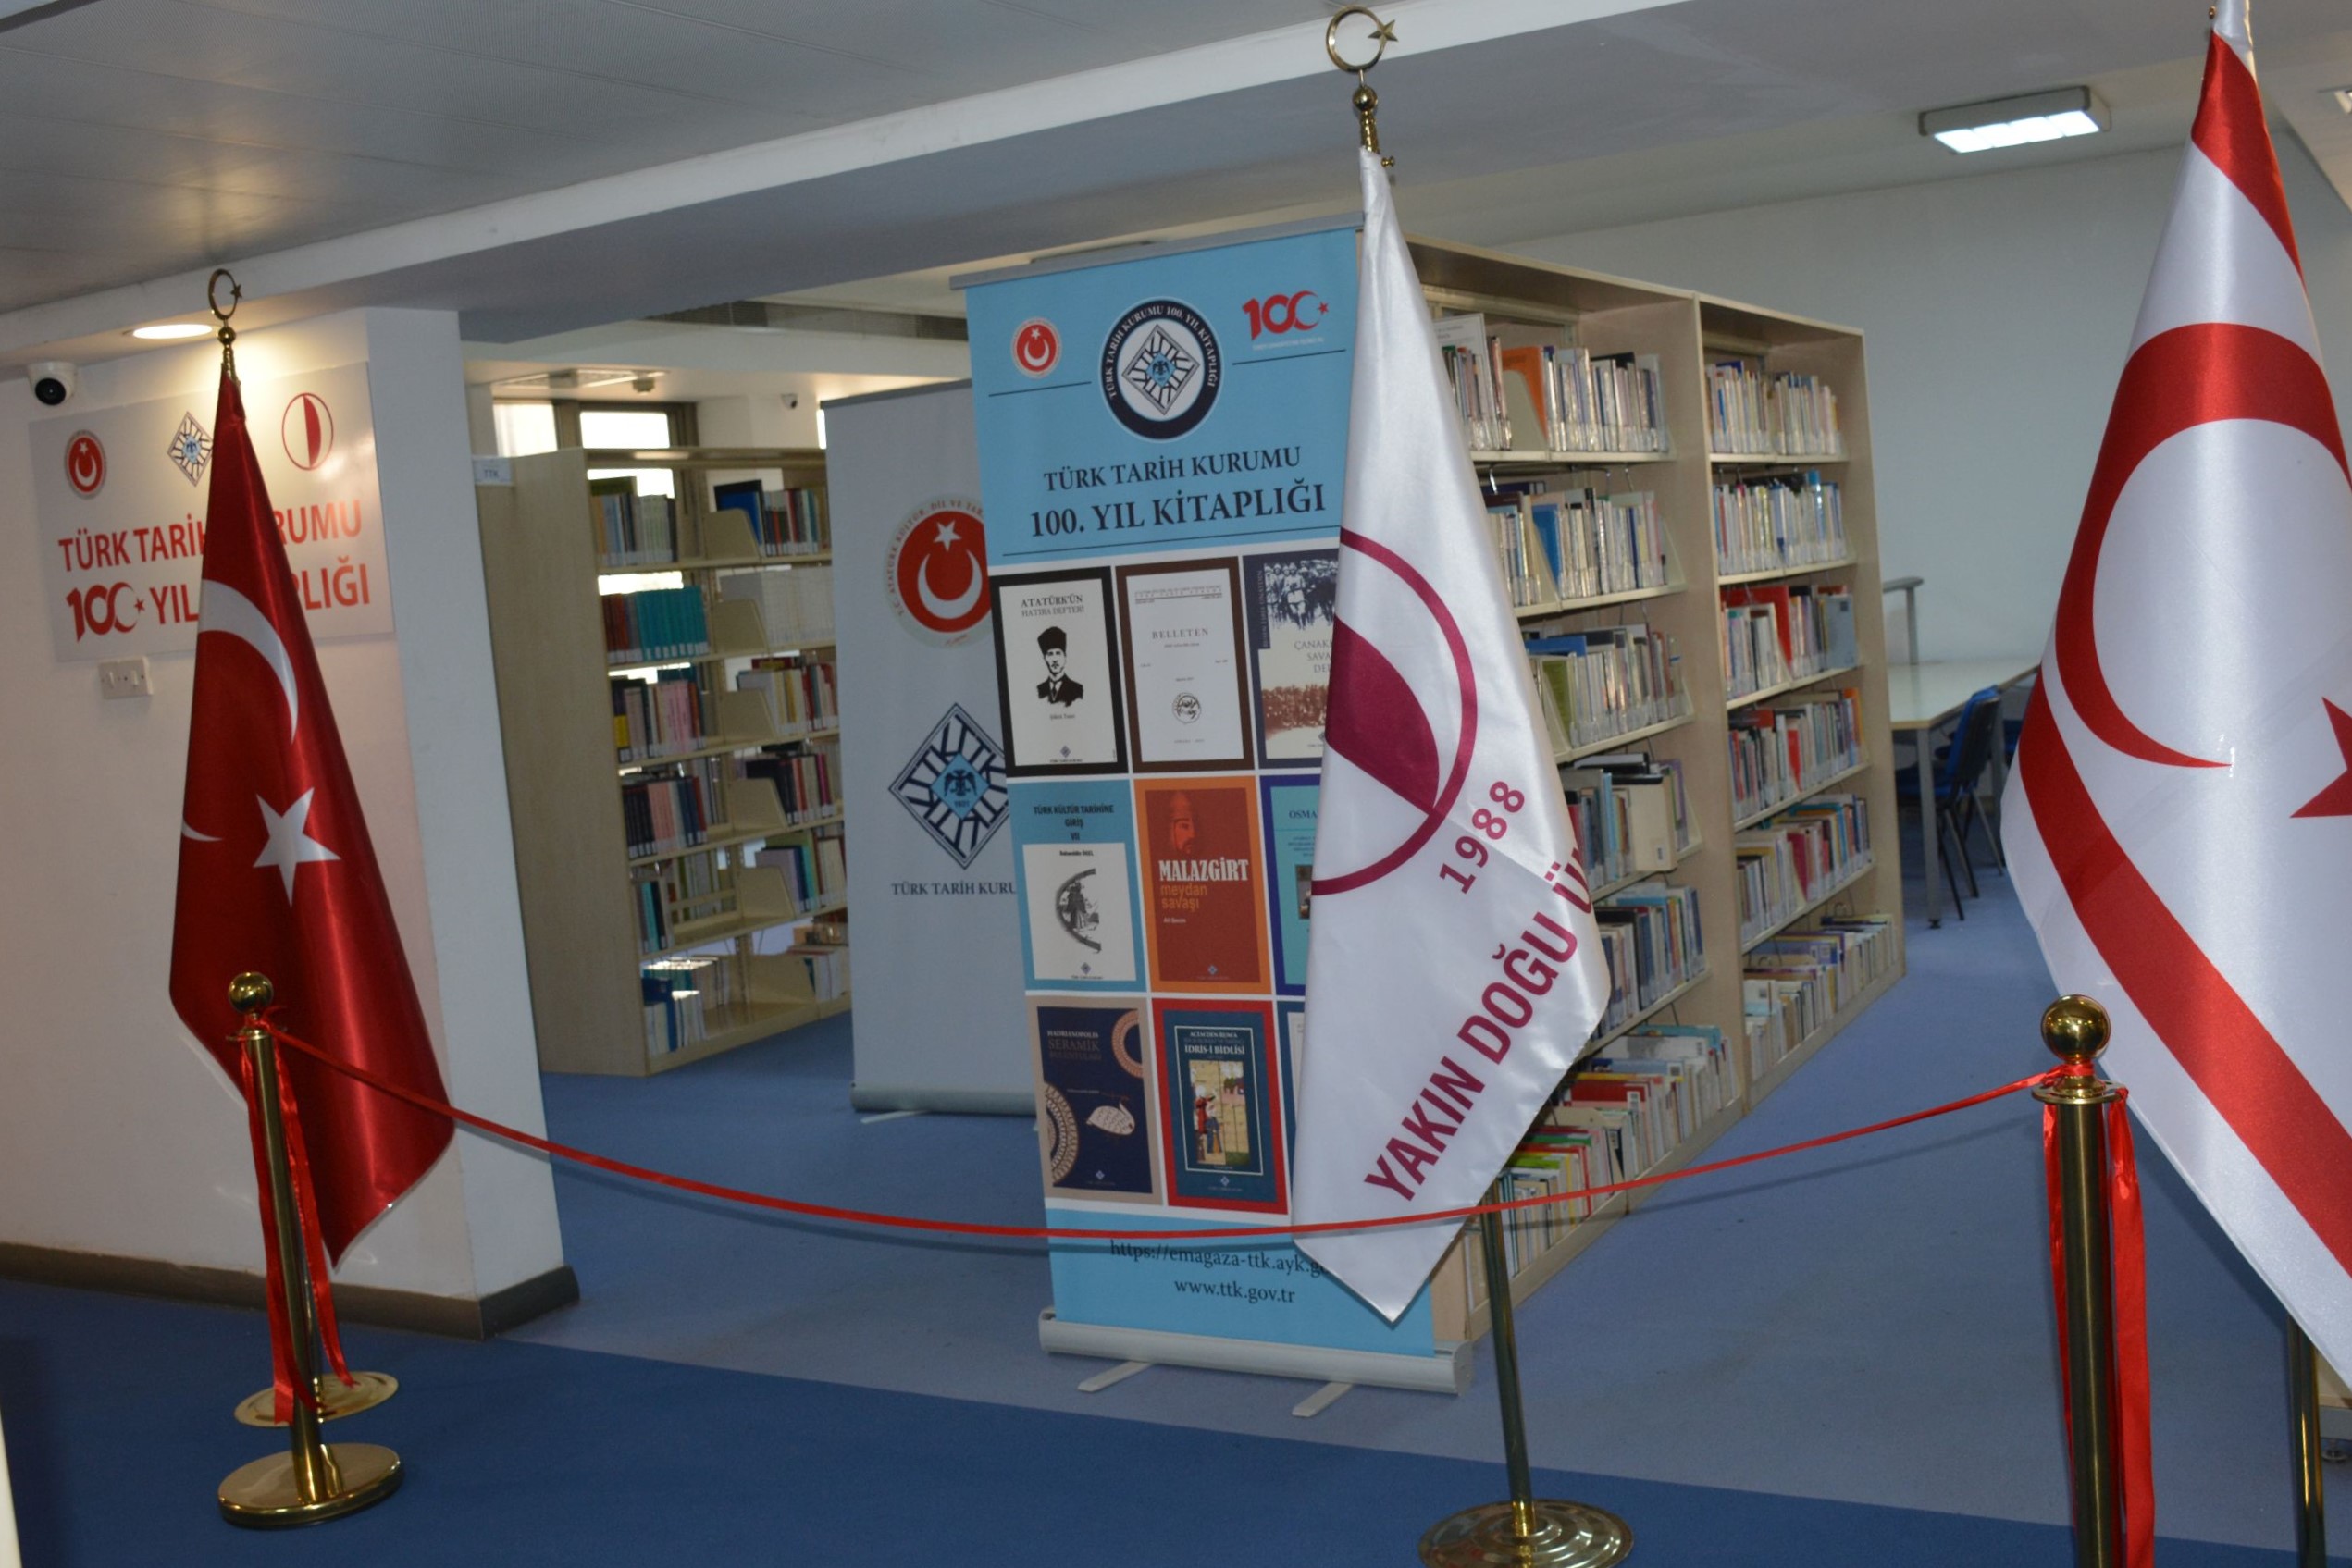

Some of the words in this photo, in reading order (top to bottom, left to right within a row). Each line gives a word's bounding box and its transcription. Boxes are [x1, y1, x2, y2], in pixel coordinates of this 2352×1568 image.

[1122, 305, 1164, 332] KURUMU
[1186, 313, 1200, 331] YIL
[1044, 465, 1107, 491] TÜRK
[1110, 455, 1185, 485] TARİH
[1191, 446, 1301, 476] KURUMU
[1031, 508, 1085, 537] 100.
[1091, 502, 1145, 531] YIL
[1153, 477, 1327, 525] KİTAPLIĞI
[58, 527, 131, 572] TÜRK
[273, 500, 362, 546] RUMU
[149, 584, 200, 624] YIL
[291, 555, 370, 611] LIĞI
[1152, 627, 1208, 639] BELLETEN
[1307, 652, 1331, 661] SAVA
[1314, 664, 1331, 673] DE
[1288, 810, 1318, 819] OSMA
[1439, 780, 1526, 895] 1988
[1158, 857, 1249, 882] MALAZGİRT
[892, 881, 928, 895] TÜRK
[932, 880, 974, 895] TARİH
[1161, 883, 1207, 898] meydan
[1162, 897, 1199, 912] savaşı
[1364, 1056, 1485, 1202] YAKIN
[1457, 911, 1578, 1065] DOĞU
[1544, 847, 1591, 914] Ü
[1110, 1239, 1324, 1278] https://emagaza-ttk.ayk.g
[1174, 1280, 1295, 1303] www.ttk.gov.tr
